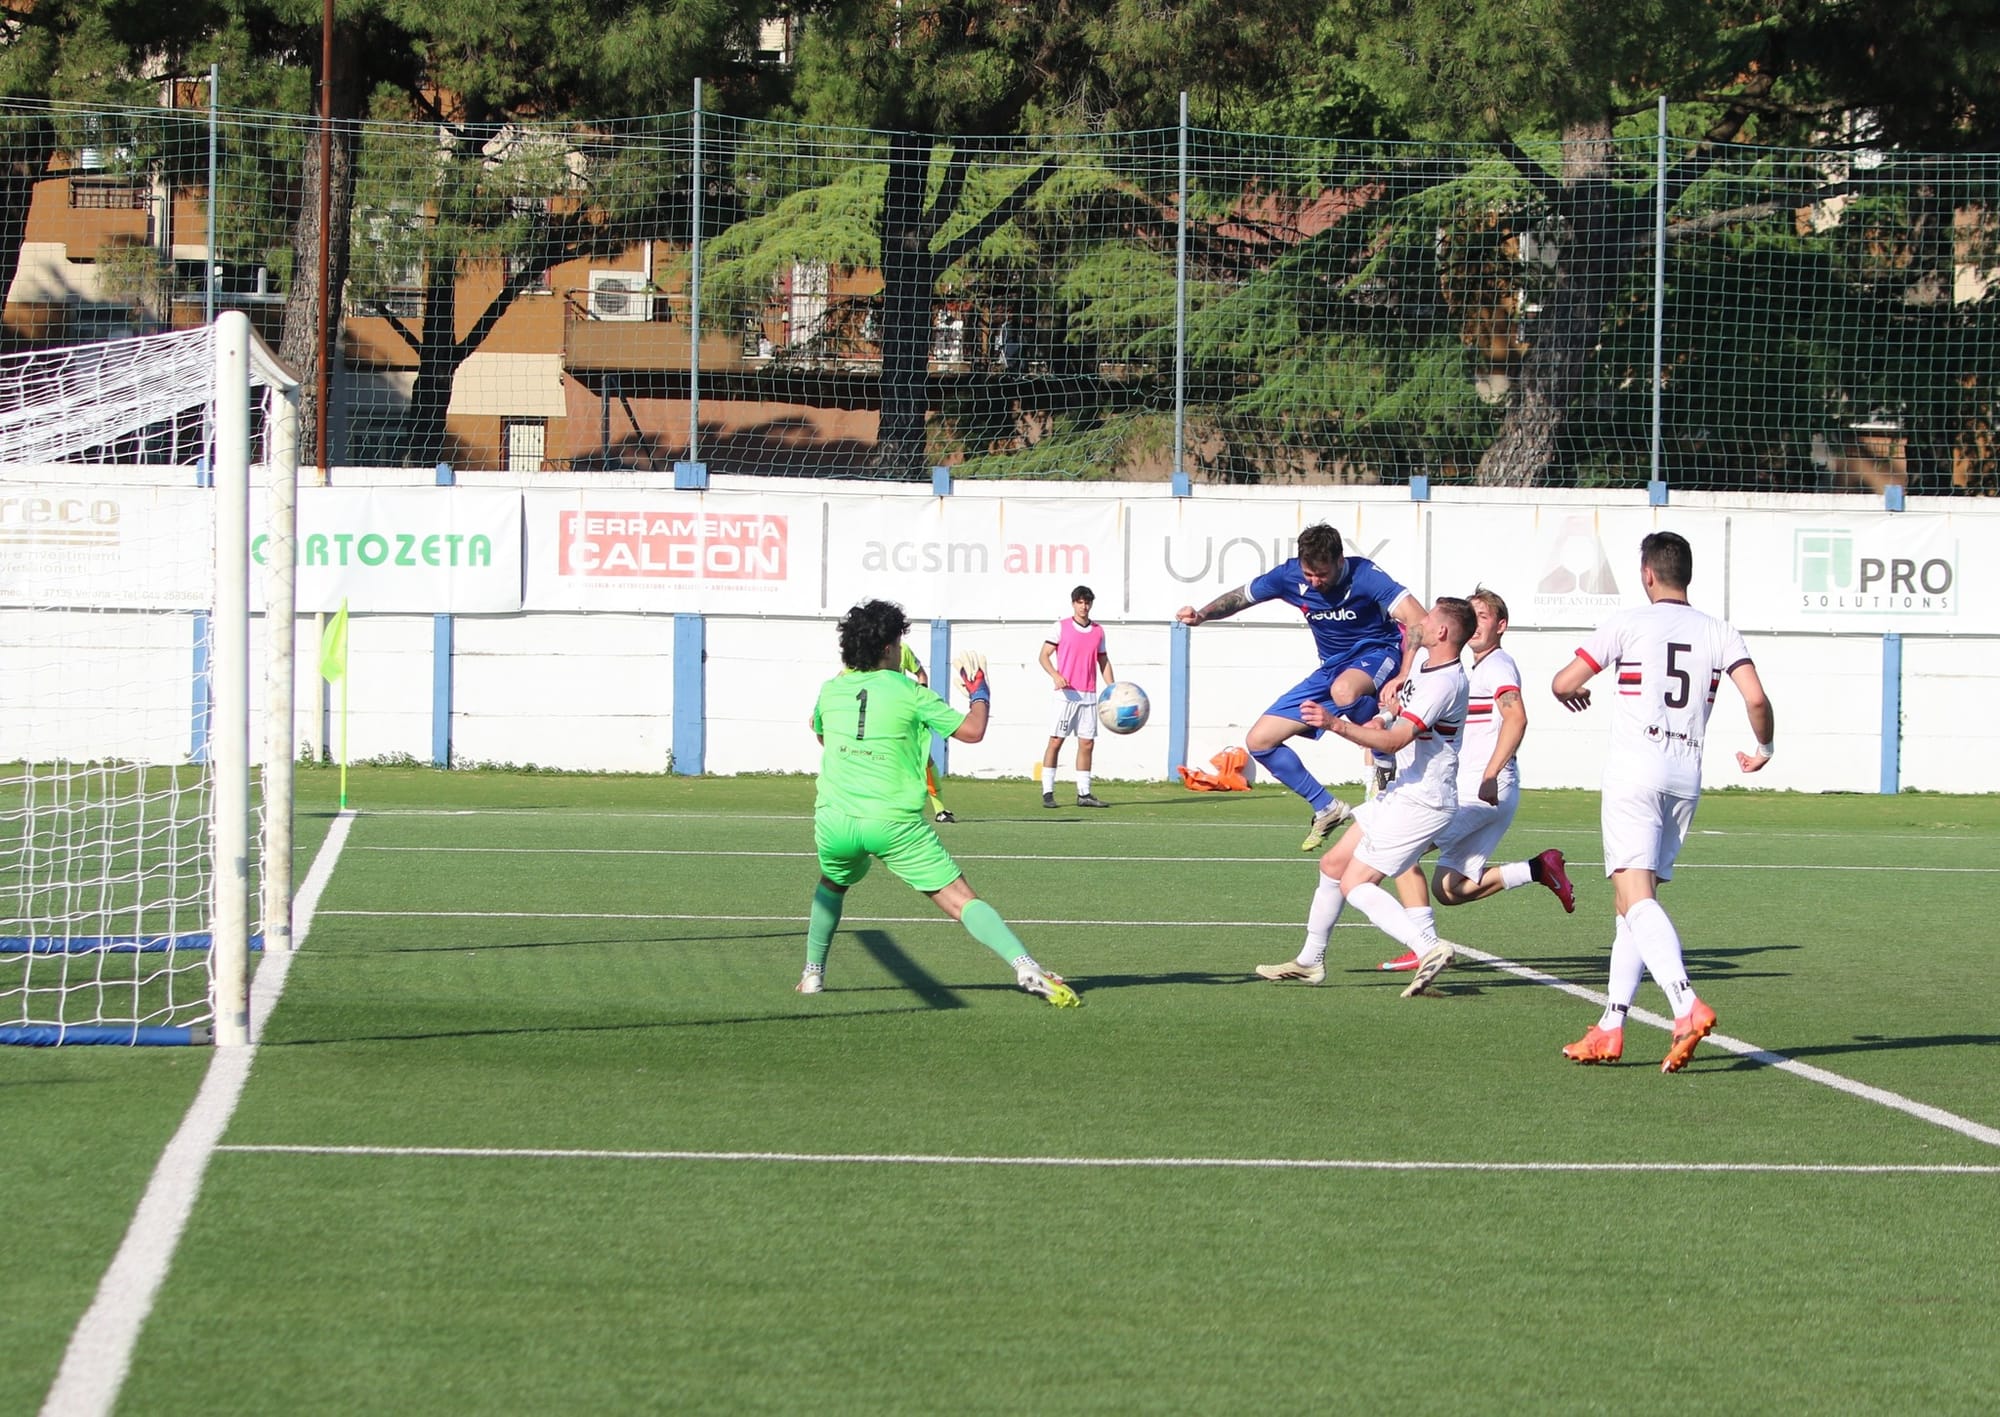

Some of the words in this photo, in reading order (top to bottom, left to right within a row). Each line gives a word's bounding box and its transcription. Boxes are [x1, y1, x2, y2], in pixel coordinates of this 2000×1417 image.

[568, 517, 781, 540] FERRAMENTA
[252, 533, 491, 567] CRTOZETA
[568, 541, 779, 574] CALDON
[1860, 557, 1953, 595] PRO
[1802, 595, 1948, 609] SOLUTIONS
[1664, 642, 1692, 709] 5
[855, 688, 868, 741] 1
